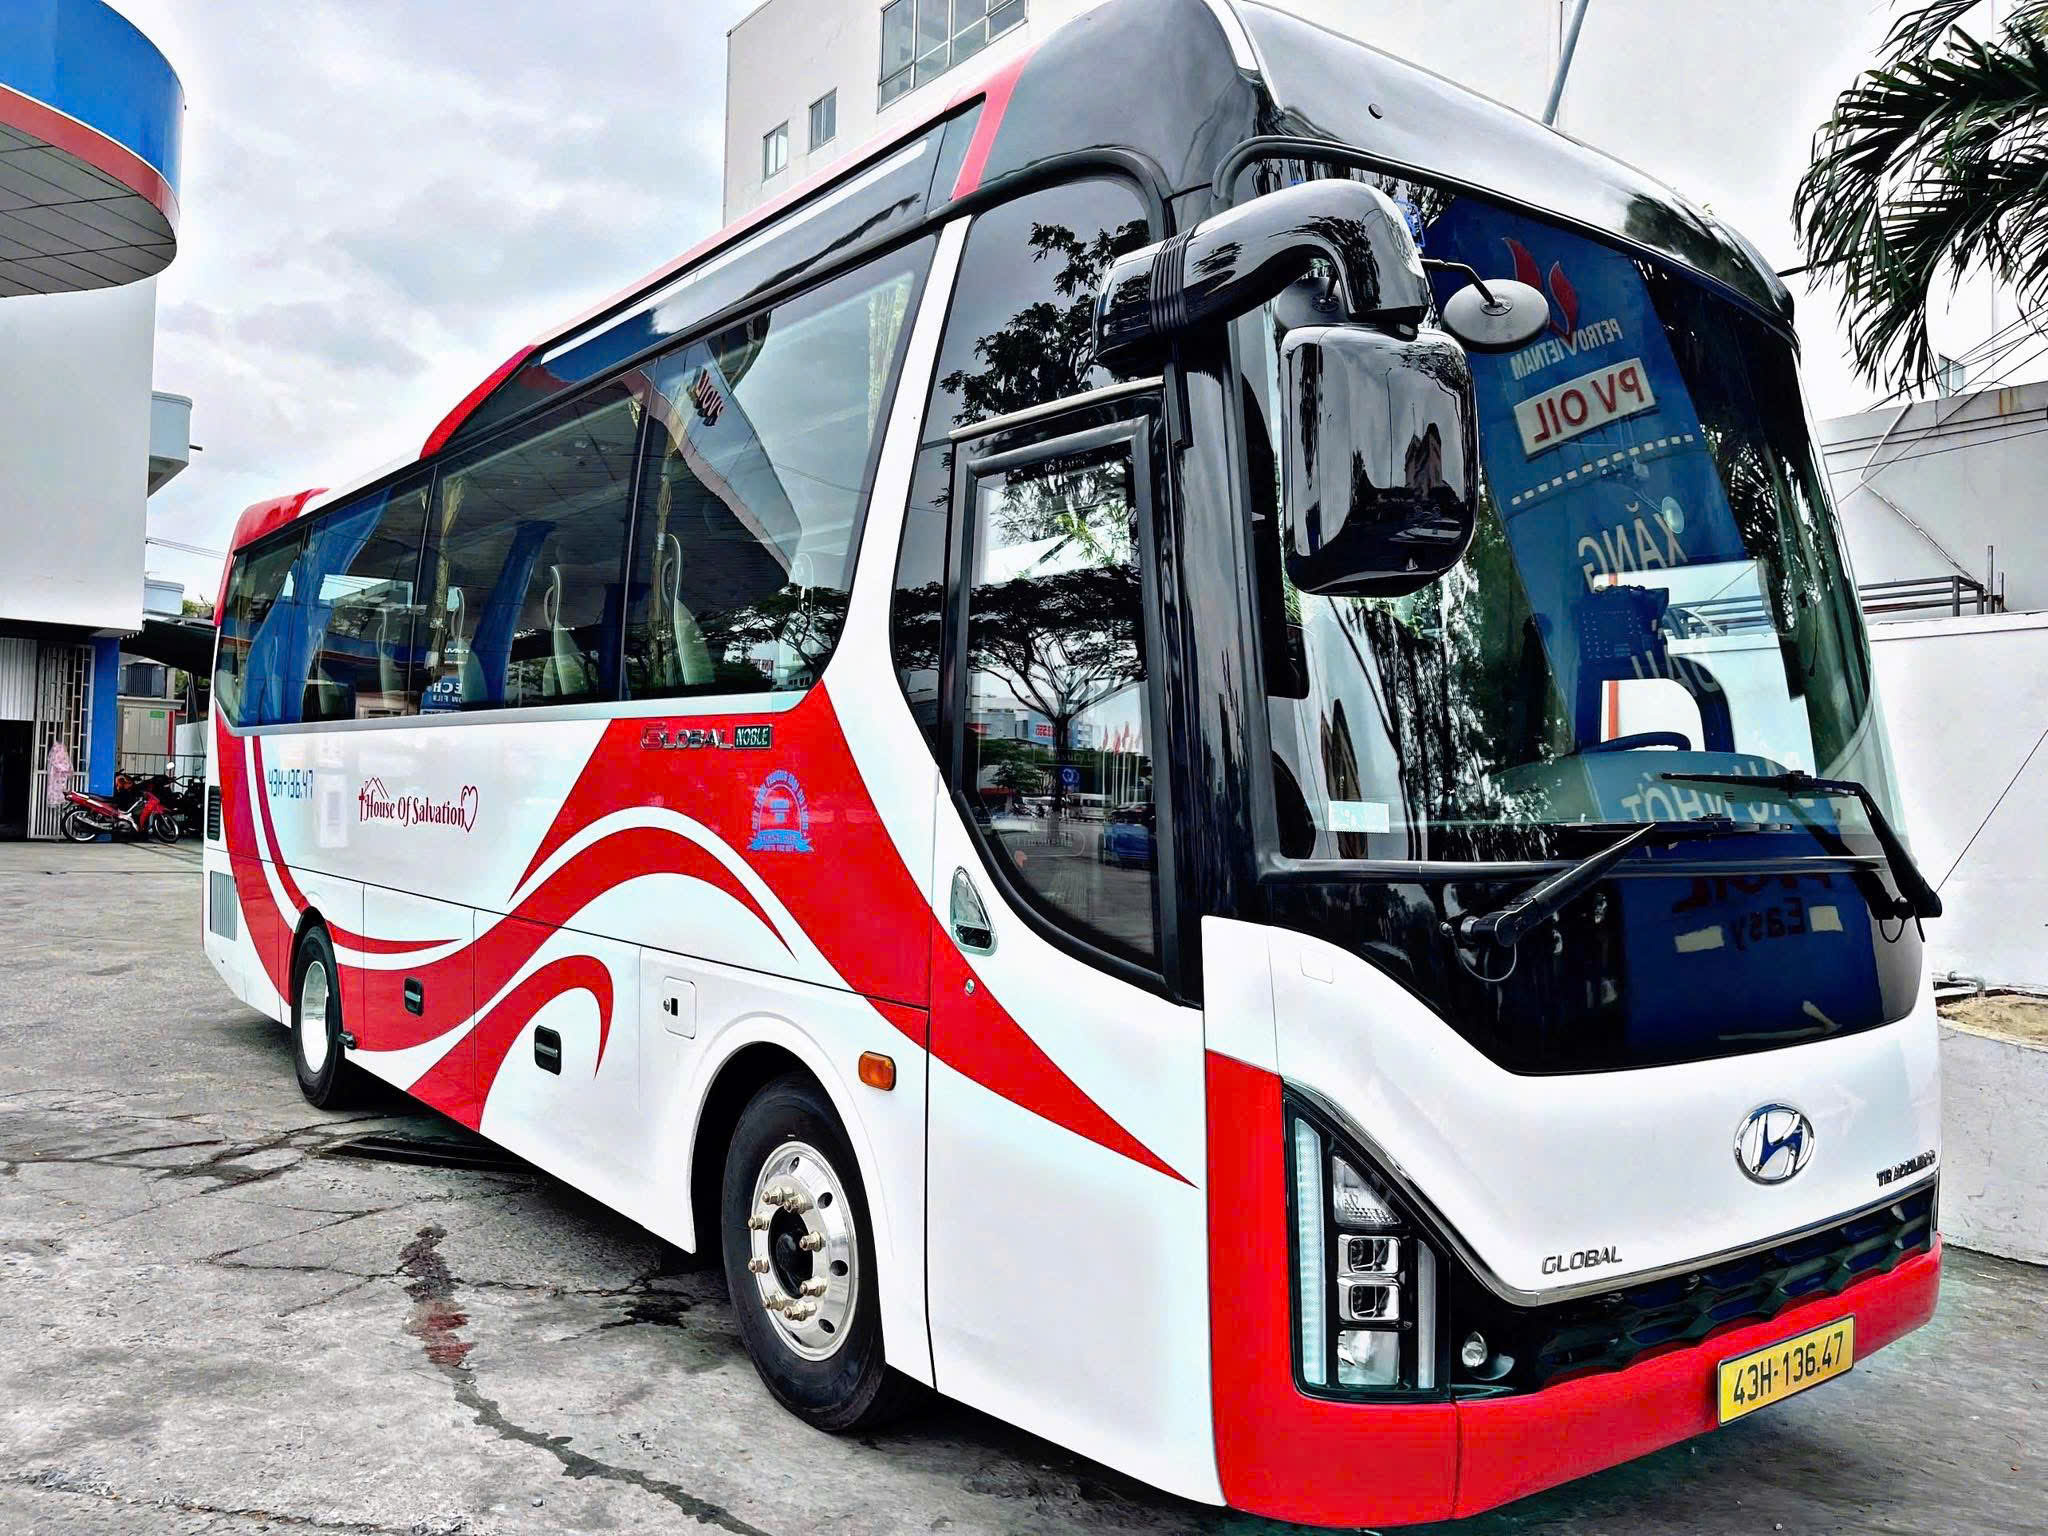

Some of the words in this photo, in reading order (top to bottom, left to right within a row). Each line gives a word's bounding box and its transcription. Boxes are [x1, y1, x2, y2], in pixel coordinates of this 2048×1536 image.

[736, 726, 770, 748] NOBLE
[363, 789, 395, 821] House
[397, 796, 412, 827] Of
[412, 797, 465, 828] Salvation
[1542, 1246, 1623, 1275] GLOBAL
[1733, 1331, 1845, 1405] 43H-136.47
